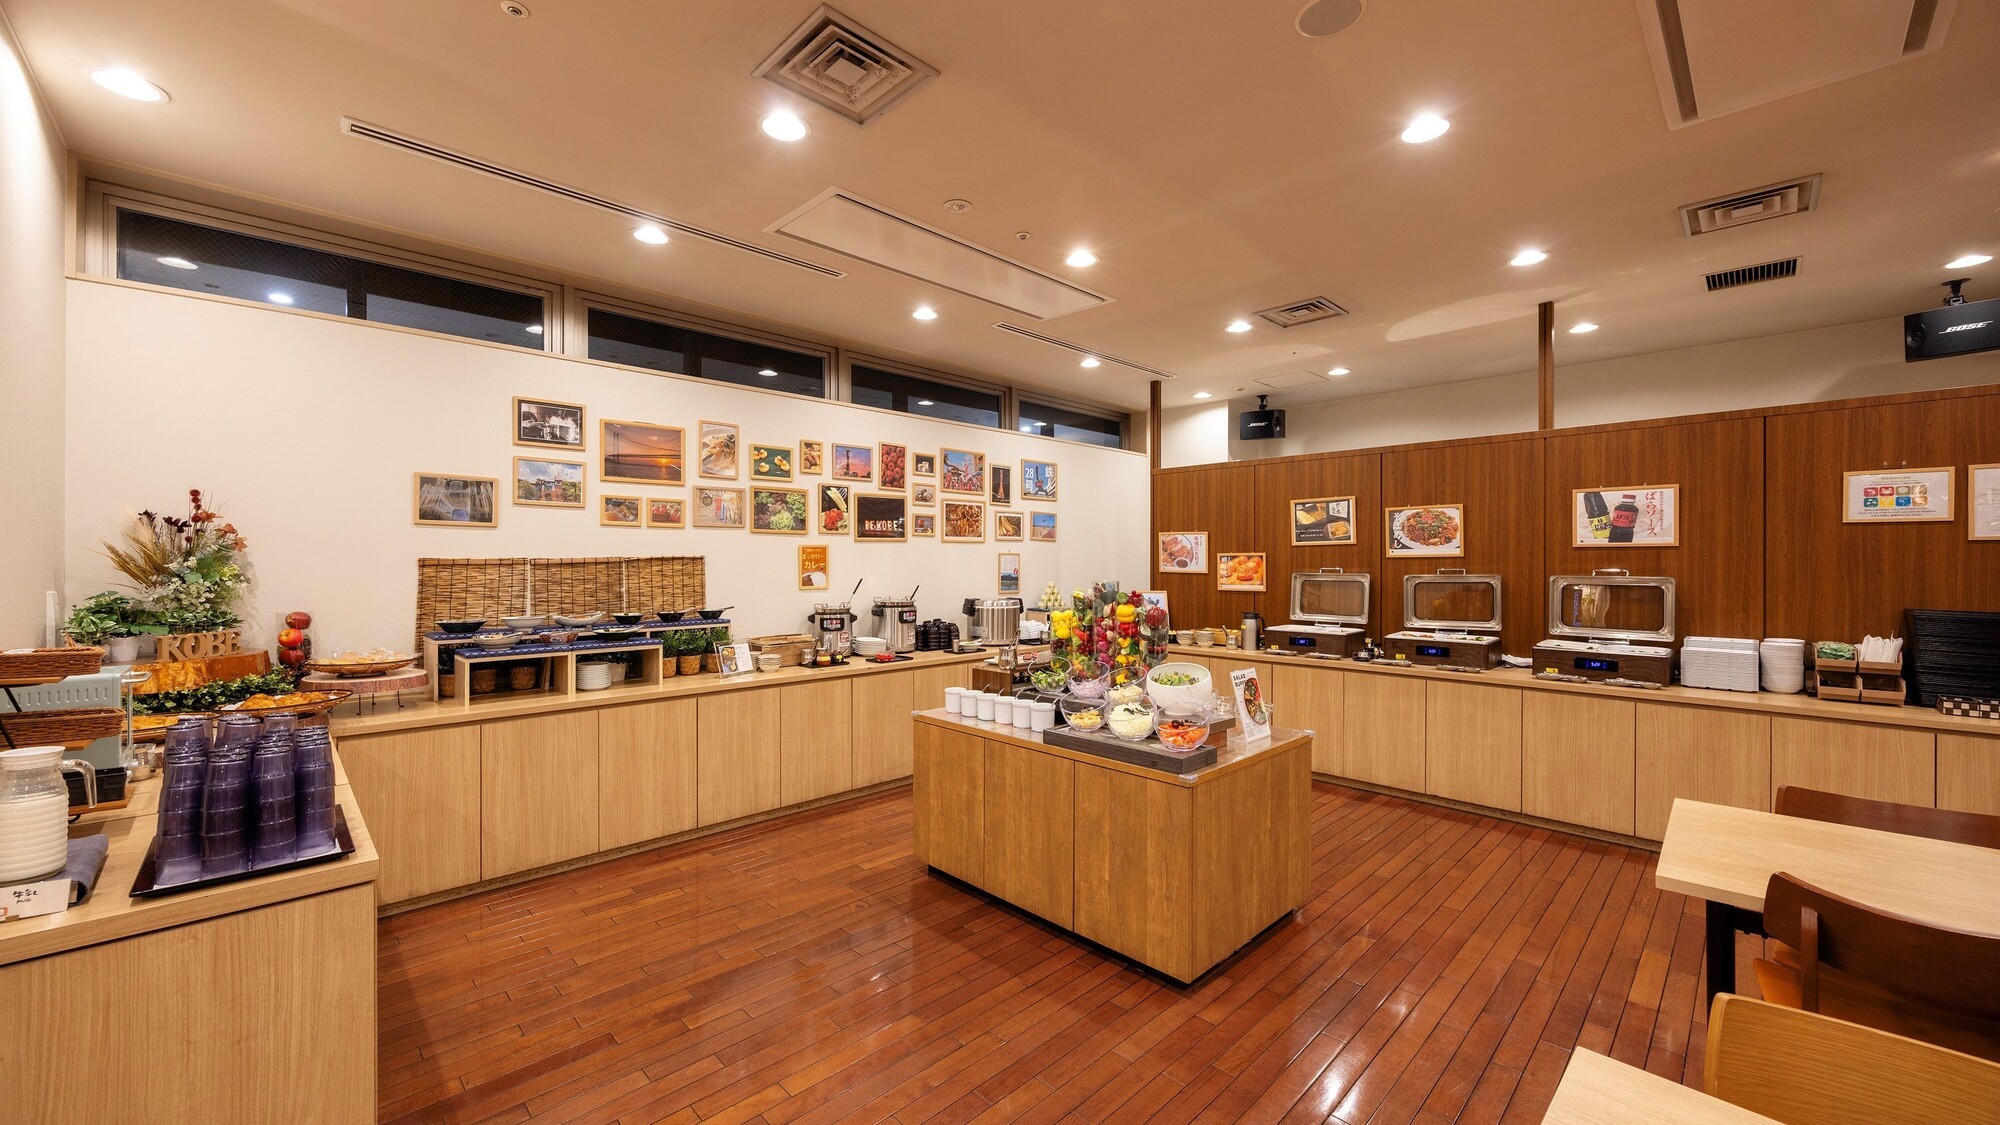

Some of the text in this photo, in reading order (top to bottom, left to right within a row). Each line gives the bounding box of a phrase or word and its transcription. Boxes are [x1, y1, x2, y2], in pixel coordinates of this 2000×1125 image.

[1941, 321, 1992, 334] BOSE
[1645, 490, 1658, 536] ばらソース
[864, 520, 899, 531] BE KOBE
[804, 561, 826, 569] カレー
[154, 628, 242, 663] KOBE
[1232, 673, 1246, 681] SALAD
